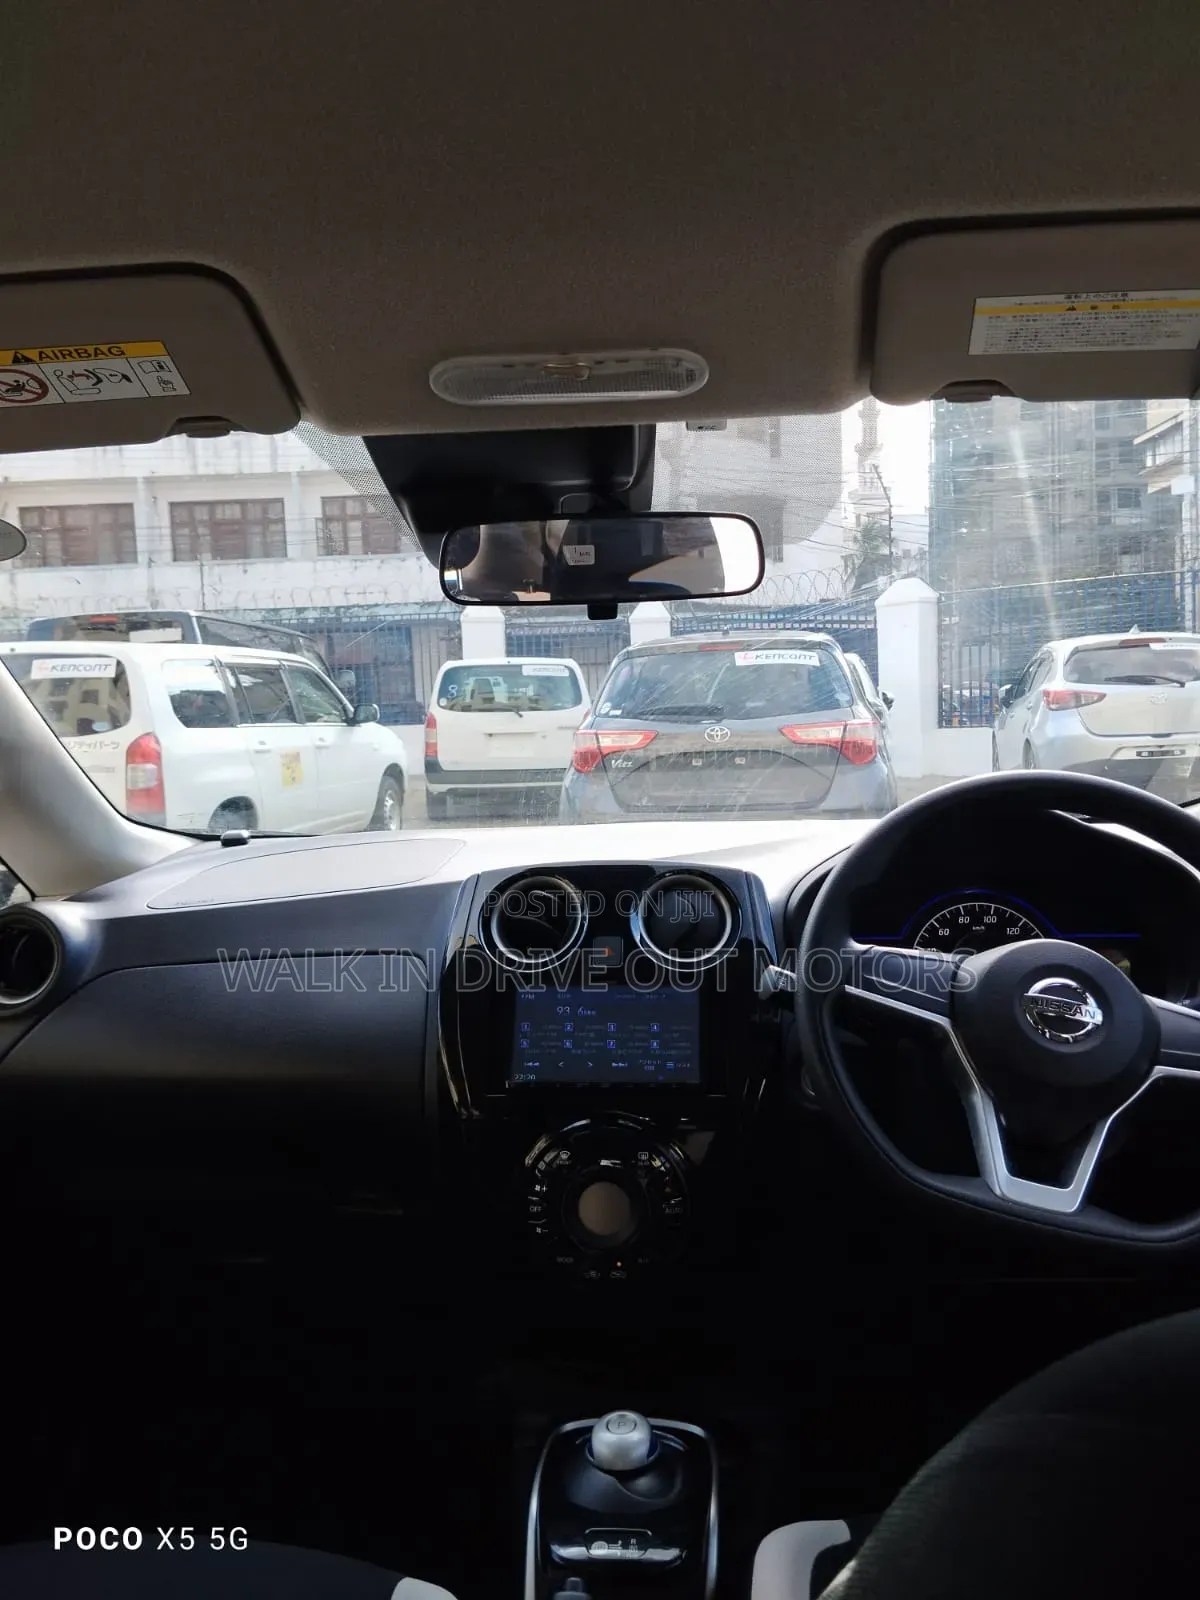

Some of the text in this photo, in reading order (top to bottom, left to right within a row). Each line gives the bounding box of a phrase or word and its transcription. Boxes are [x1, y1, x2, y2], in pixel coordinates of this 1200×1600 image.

[37, 345, 126, 362] AIRBAG
[958, 915, 970, 924] 80
[983, 915, 997, 924] 100
[938, 927, 950, 936] 60
[1006, 927, 1020, 935] 120
[1030, 998, 1096, 1019] NISSAN
